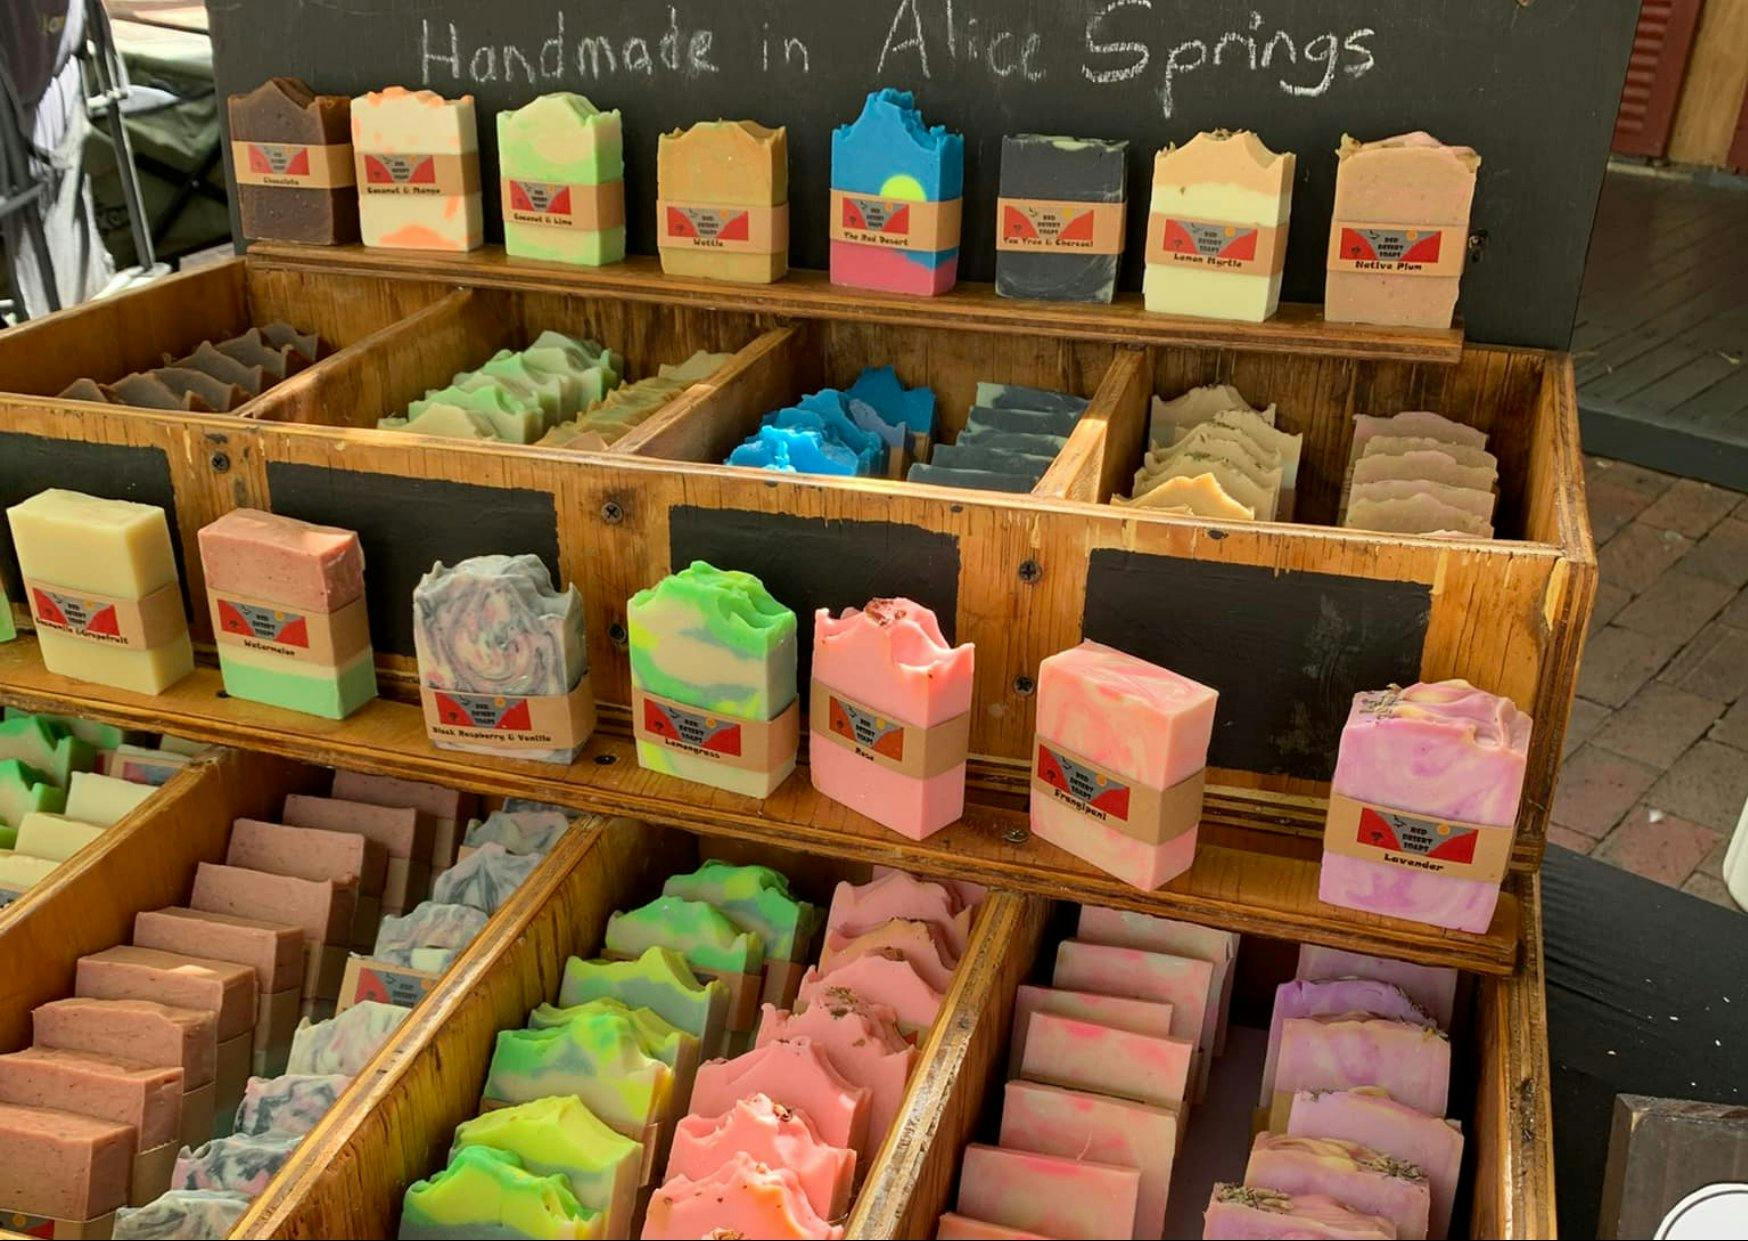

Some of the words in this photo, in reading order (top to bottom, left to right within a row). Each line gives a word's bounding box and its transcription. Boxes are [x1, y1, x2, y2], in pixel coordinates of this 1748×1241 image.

[421, 5, 719, 86] Handmade
[762, 23, 809, 73] in
[876, 0, 1046, 80] Alice
[1081, 0, 1376, 118] Springs
[693, 238, 723, 247] Wattle
[844, 231, 858, 240] The
[861, 234, 876, 242] Red
[879, 236, 908, 246] Desert
[1023, 237, 1042, 245] Tree
[1055, 239, 1093, 247] Charcoal
[1174, 253, 1203, 263] Lemon
[1207, 257, 1242, 267] Myrtle
[1355, 261, 1392, 270] Native
[1397, 262, 1421, 270] Plum
[81, 629, 128, 644] Grapefruit
[244, 639, 295, 656] Watermelon
[433, 727, 455, 736] Black
[459, 730, 505, 741] Raspberry
[518, 734, 551, 742] Vanilla
[665, 736, 720, 758] Lemongrass
[855, 747, 874, 761] Rose
[1054, 789, 1107, 821] Frangipani
[1410, 826, 1427, 835] RED
[1402, 833, 1433, 844] DESERT
[1384, 853, 1444, 871] Lavender
